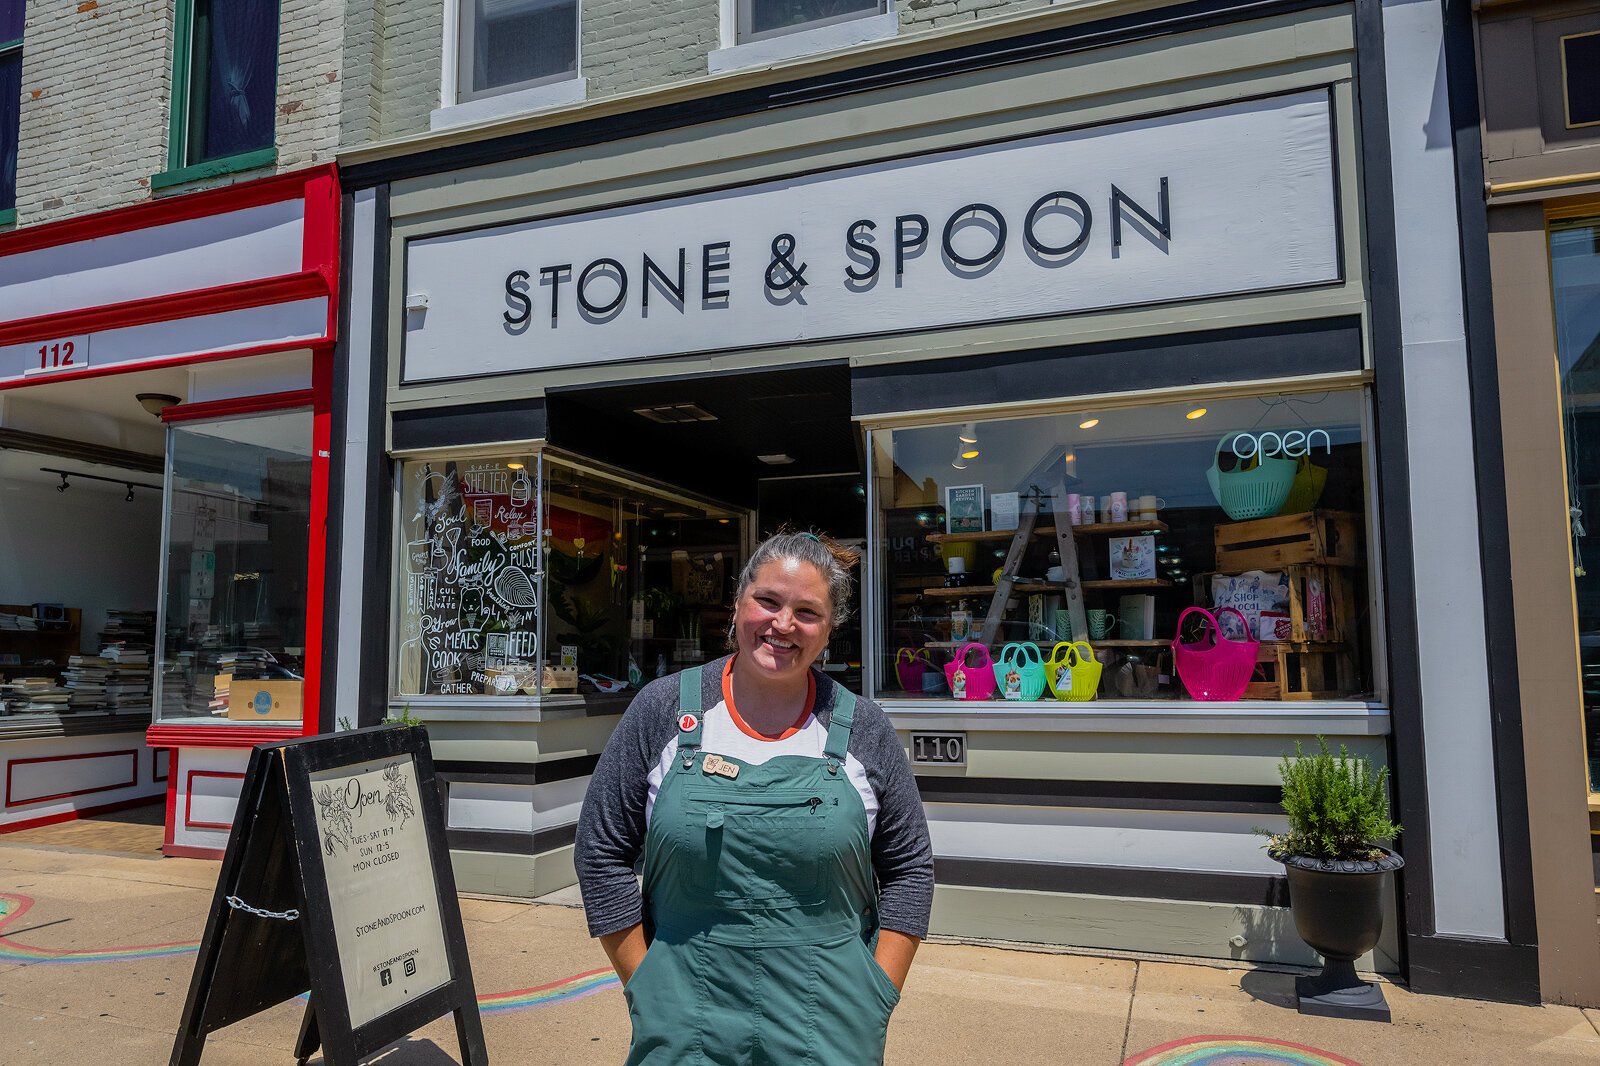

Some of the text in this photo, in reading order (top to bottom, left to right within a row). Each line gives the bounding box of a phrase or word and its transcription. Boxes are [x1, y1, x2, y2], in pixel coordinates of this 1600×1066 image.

[503, 176, 1171, 324] STONE & SPOON
[39, 342, 75, 369] 112
[1232, 429, 1331, 466] open
[464, 471, 508, 494] SHELTER
[494, 505, 527, 524] Relax
[471, 538, 491, 547] FOOD
[509, 540, 535, 552] COMFORT
[510, 547, 538, 569] PULSE
[435, 602, 456, 610] VATE
[1233, 593, 1260, 602] SHOP
[444, 632, 480, 650] MEALS
[509, 631, 538, 657] FEED
[432, 650, 462, 669] COOK
[440, 683, 473, 694] GATHER
[471, 671, 500, 688] PREPAR
[916, 737, 961, 760] 110
[719, 764, 735, 774] JEN
[344, 778, 384, 817] Open
[352, 830, 380, 845] TUES-SAT
[360, 841, 390, 857] SUN 12-5
[353, 851, 400, 873] MON CLOSED
